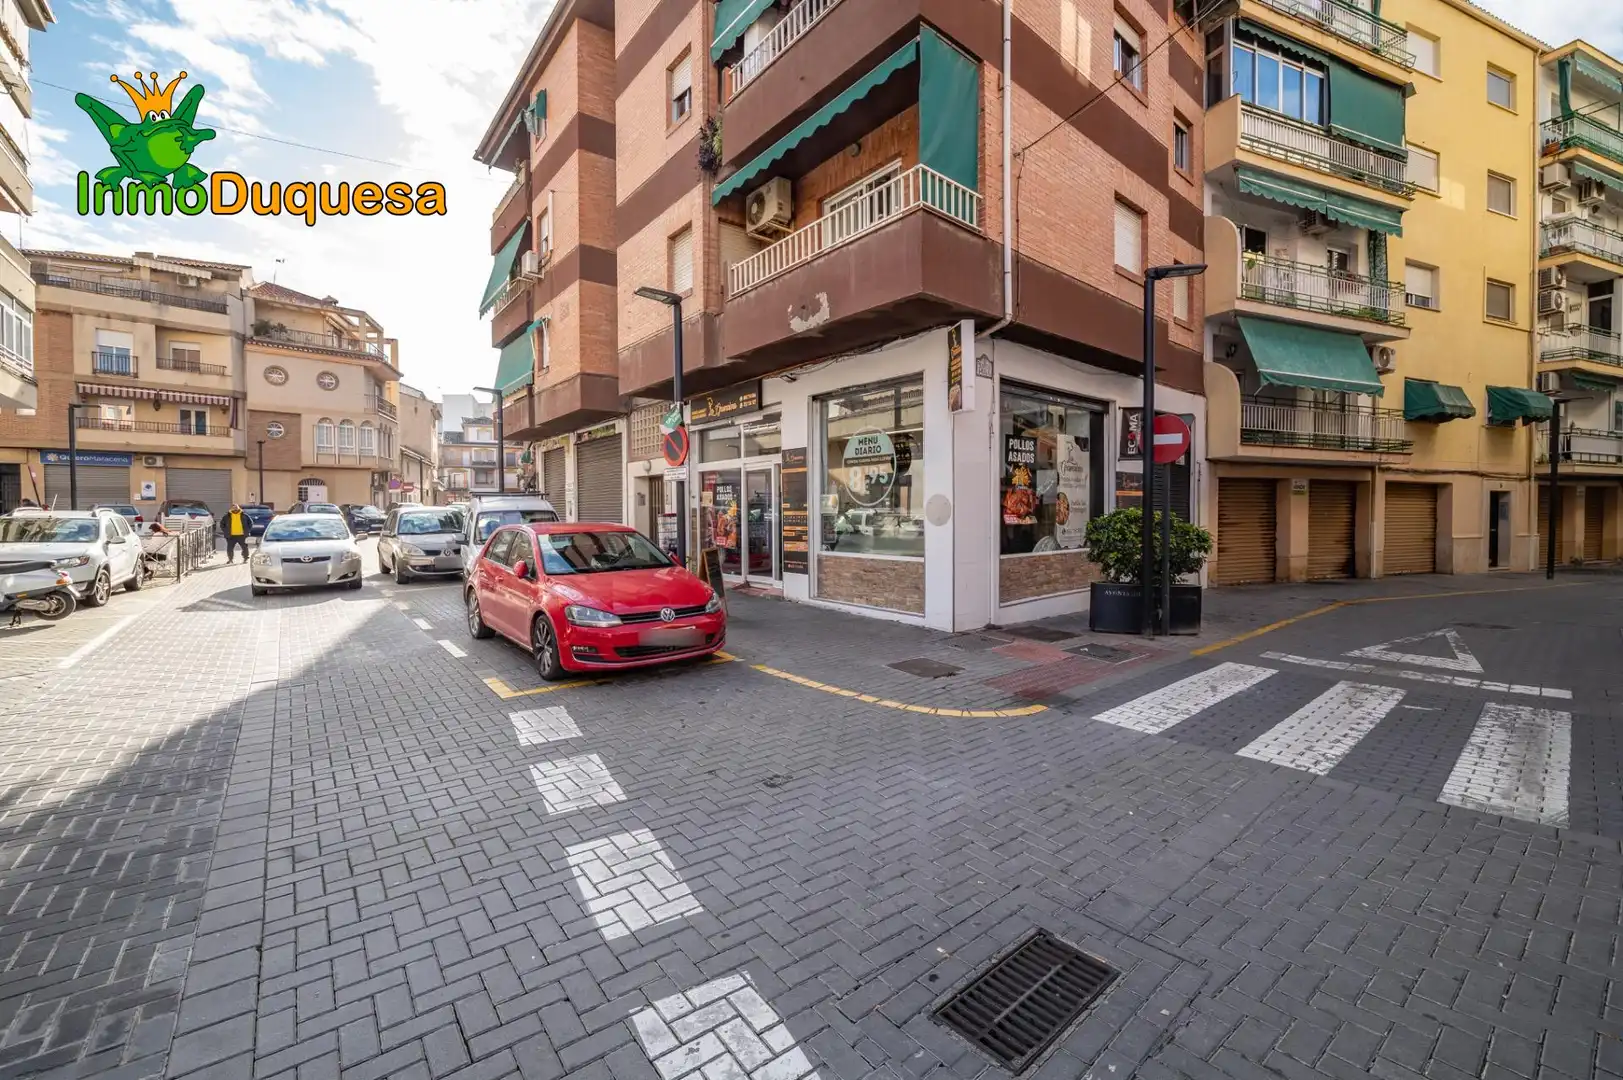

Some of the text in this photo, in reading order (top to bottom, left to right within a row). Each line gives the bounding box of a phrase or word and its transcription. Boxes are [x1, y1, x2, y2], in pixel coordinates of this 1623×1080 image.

[854, 445, 881, 456] DIARIO
[1009, 438, 1034, 452] POLLOS
[59, 453, 128, 463] QueroMaracena
[1008, 451, 1035, 464] ASADOS
